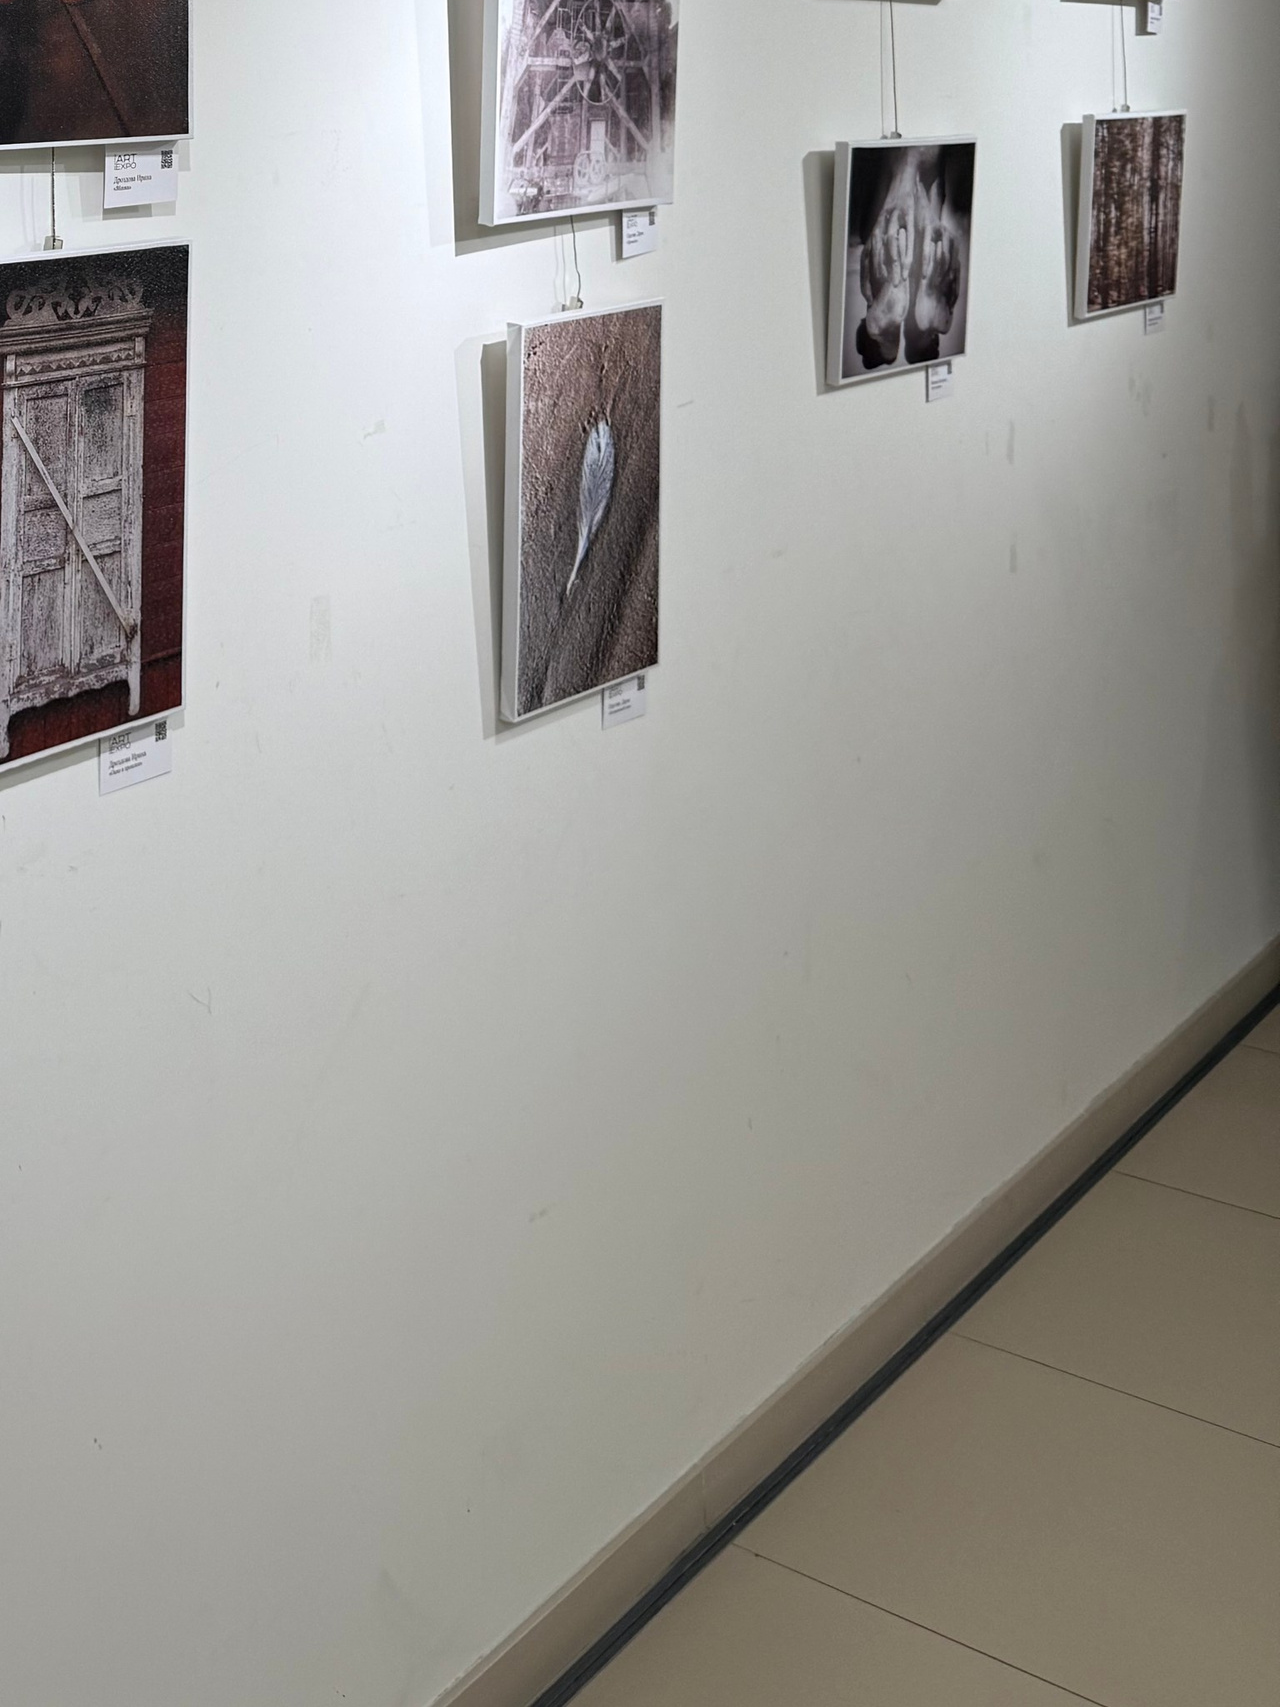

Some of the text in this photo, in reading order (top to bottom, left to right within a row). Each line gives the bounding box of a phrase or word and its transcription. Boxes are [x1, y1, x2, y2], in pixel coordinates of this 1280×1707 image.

[117, 153, 138, 163] ART
[115, 162, 137, 171] EXPO
[111, 732, 132, 746] ART
